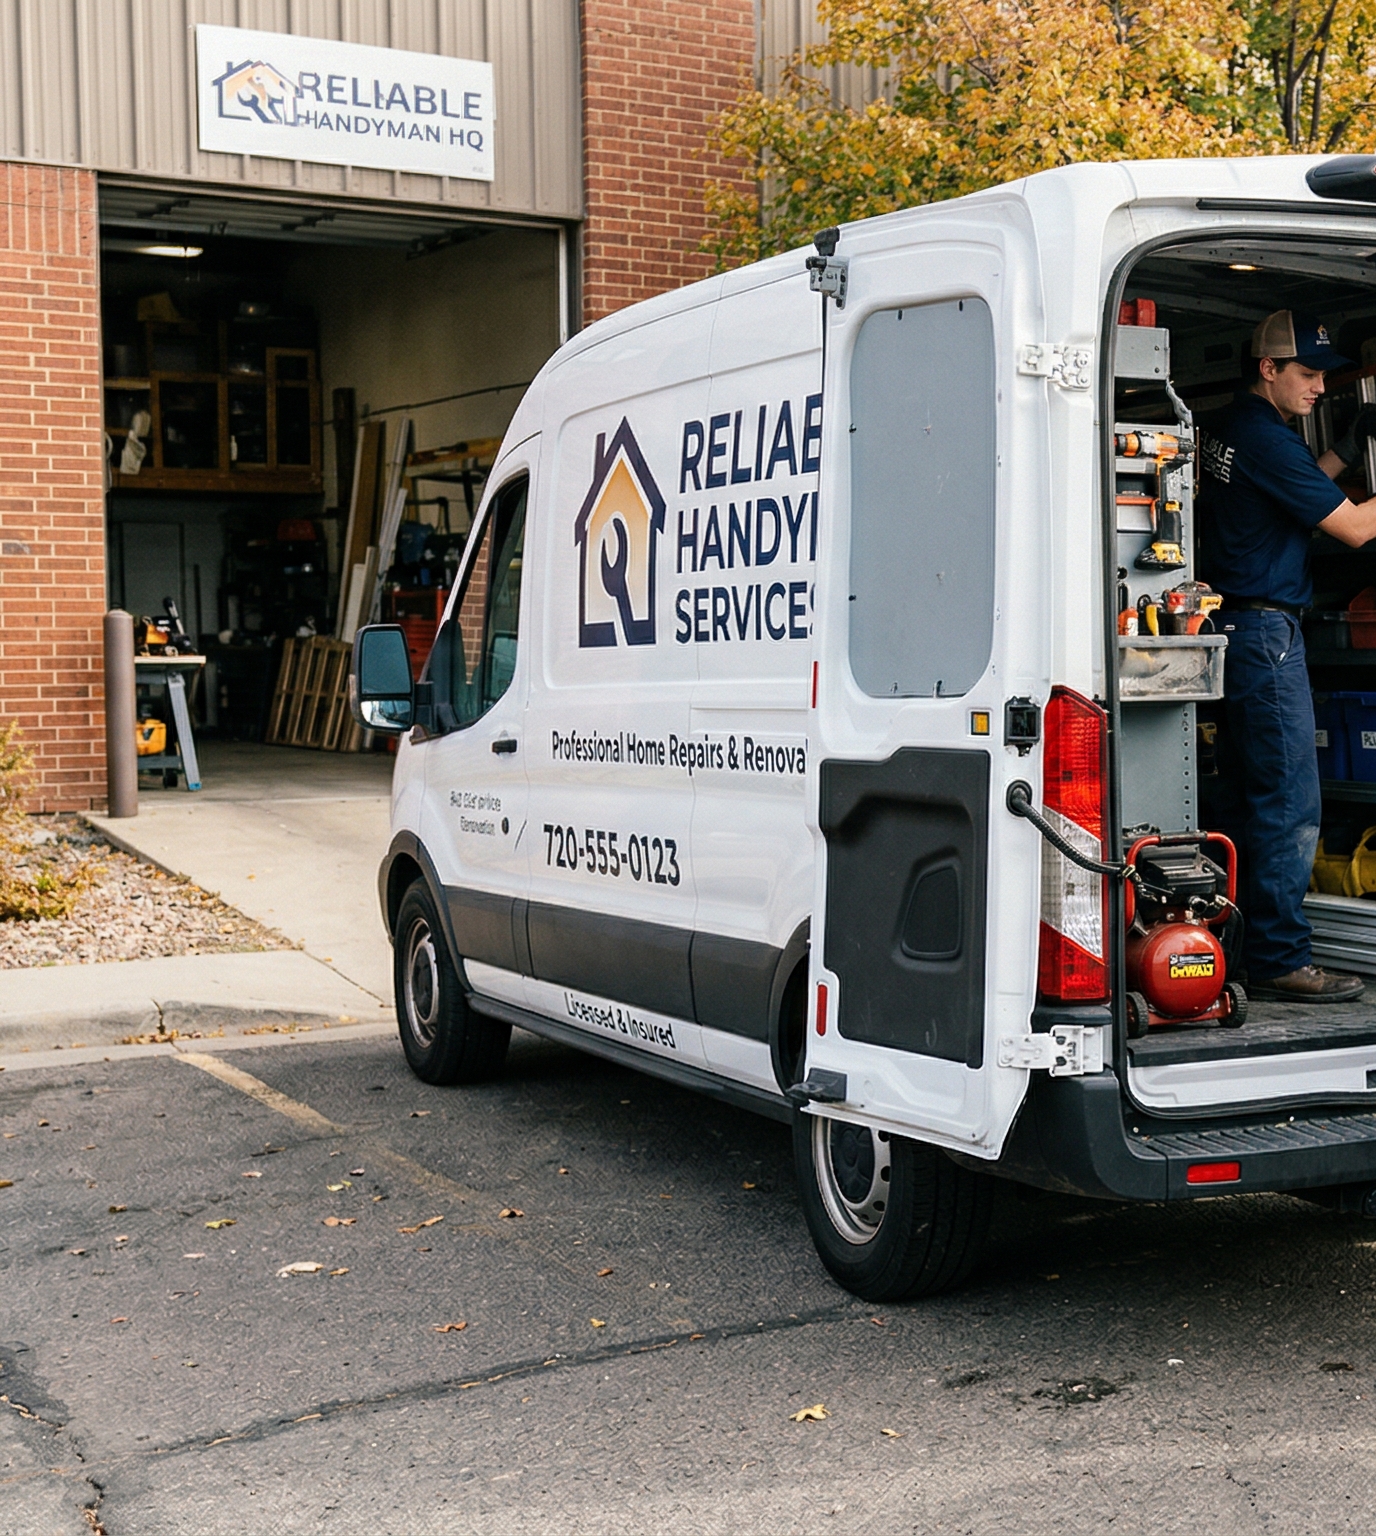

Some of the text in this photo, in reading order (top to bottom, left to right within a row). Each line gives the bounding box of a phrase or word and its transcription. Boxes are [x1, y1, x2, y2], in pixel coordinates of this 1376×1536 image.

[299, 71, 483, 121] RELIABLE
[304, 109, 484, 152] HANDYMAN HQ
[552, 730, 624, 763] Professional
[627, 733, 666, 766] Home
[669, 734, 724, 776] Repairs
[728, 735, 739, 771] &
[543, 824, 681, 887] 720-555-0123
[564, 992, 677, 1050] Licensed & Insured
